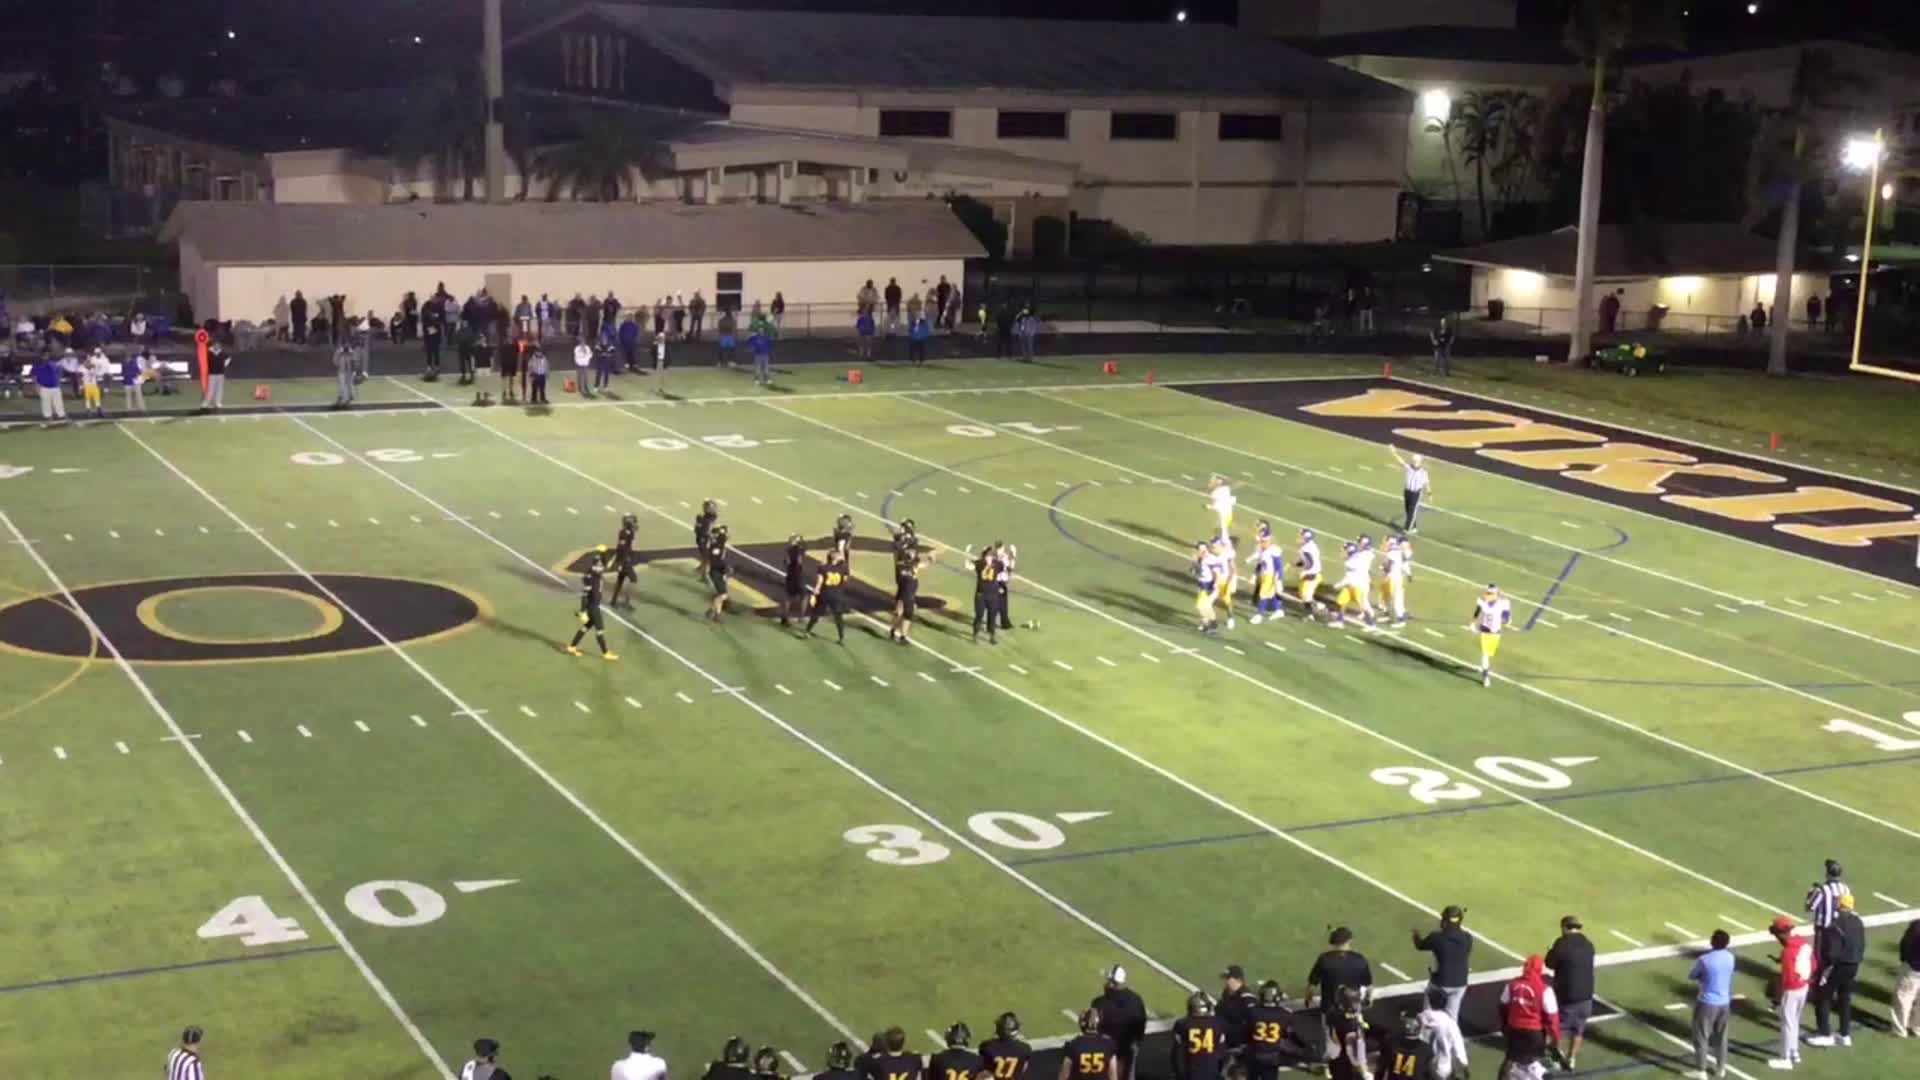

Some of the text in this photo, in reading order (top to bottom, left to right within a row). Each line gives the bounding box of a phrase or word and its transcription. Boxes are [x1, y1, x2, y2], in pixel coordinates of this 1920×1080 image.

[1370, 755, 1572, 804] 20
[843, 811, 1066, 865] 30
[196, 879, 447, 946] 40
[1187, 1028, 1215, 1053] 54
[1253, 1021, 1281, 1043] 33
[992, 1056, 1019, 1079] 27
[1079, 1052, 1106, 1074] 55
[1393, 1053, 1417, 1077] 14
